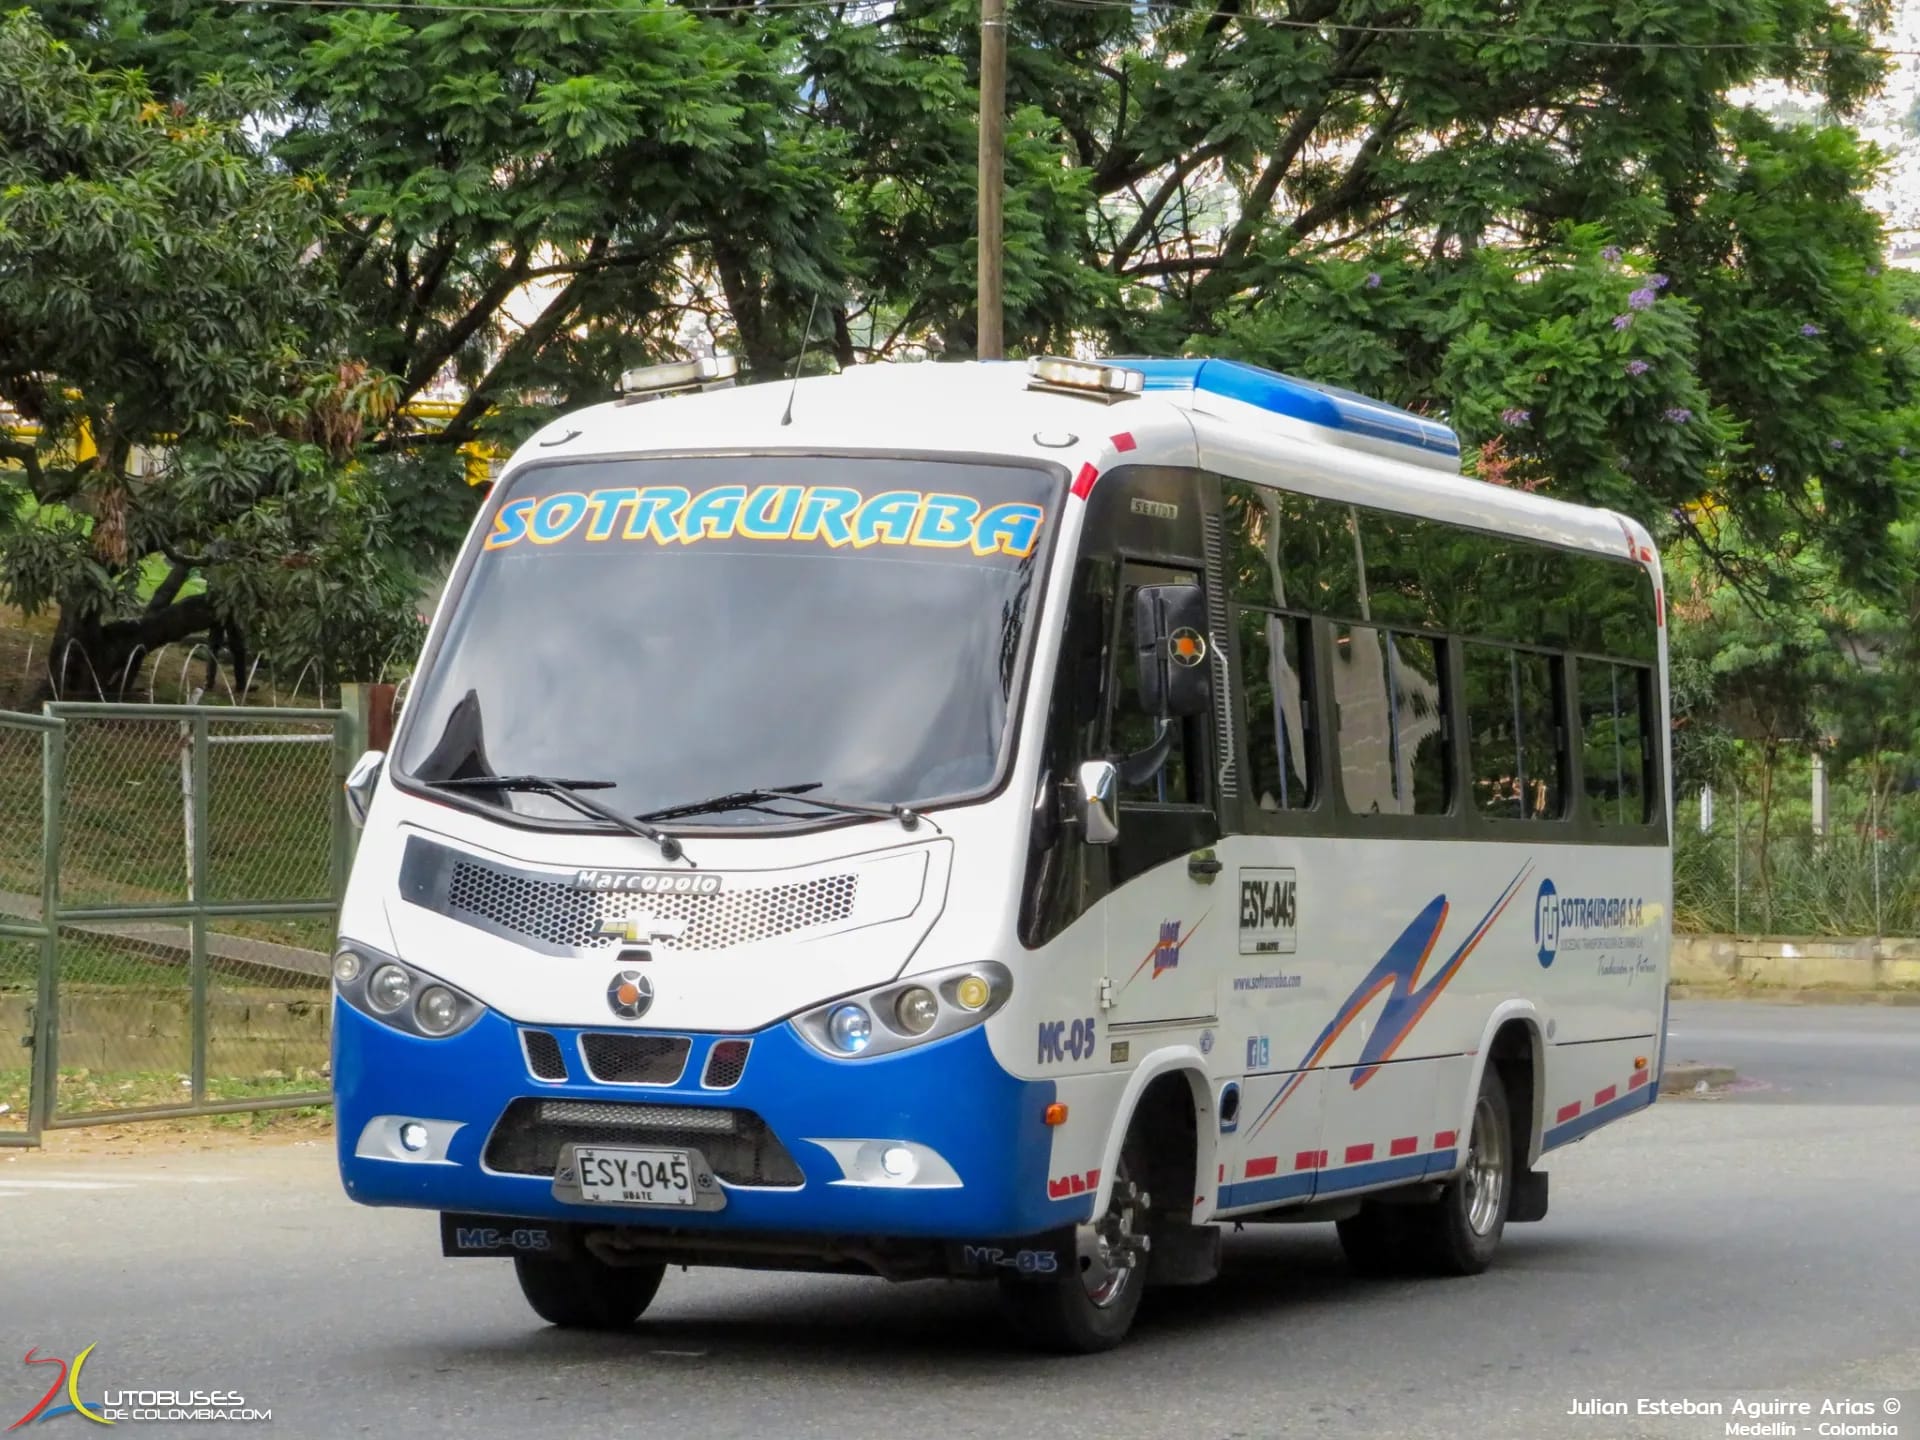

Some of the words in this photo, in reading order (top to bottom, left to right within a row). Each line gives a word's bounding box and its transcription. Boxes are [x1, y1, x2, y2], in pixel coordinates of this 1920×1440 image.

[485, 486, 1044, 556] SOTRAURABA
[577, 870, 718, 894] Marcopolo
[1240, 881, 1296, 928] ESY-045
[1561, 898, 1626, 929] SOTRAURABA
[1038, 1017, 1096, 1065] MC-05
[623, 1191, 652, 1201] UBATE
[457, 1228, 551, 1250] MC-05
